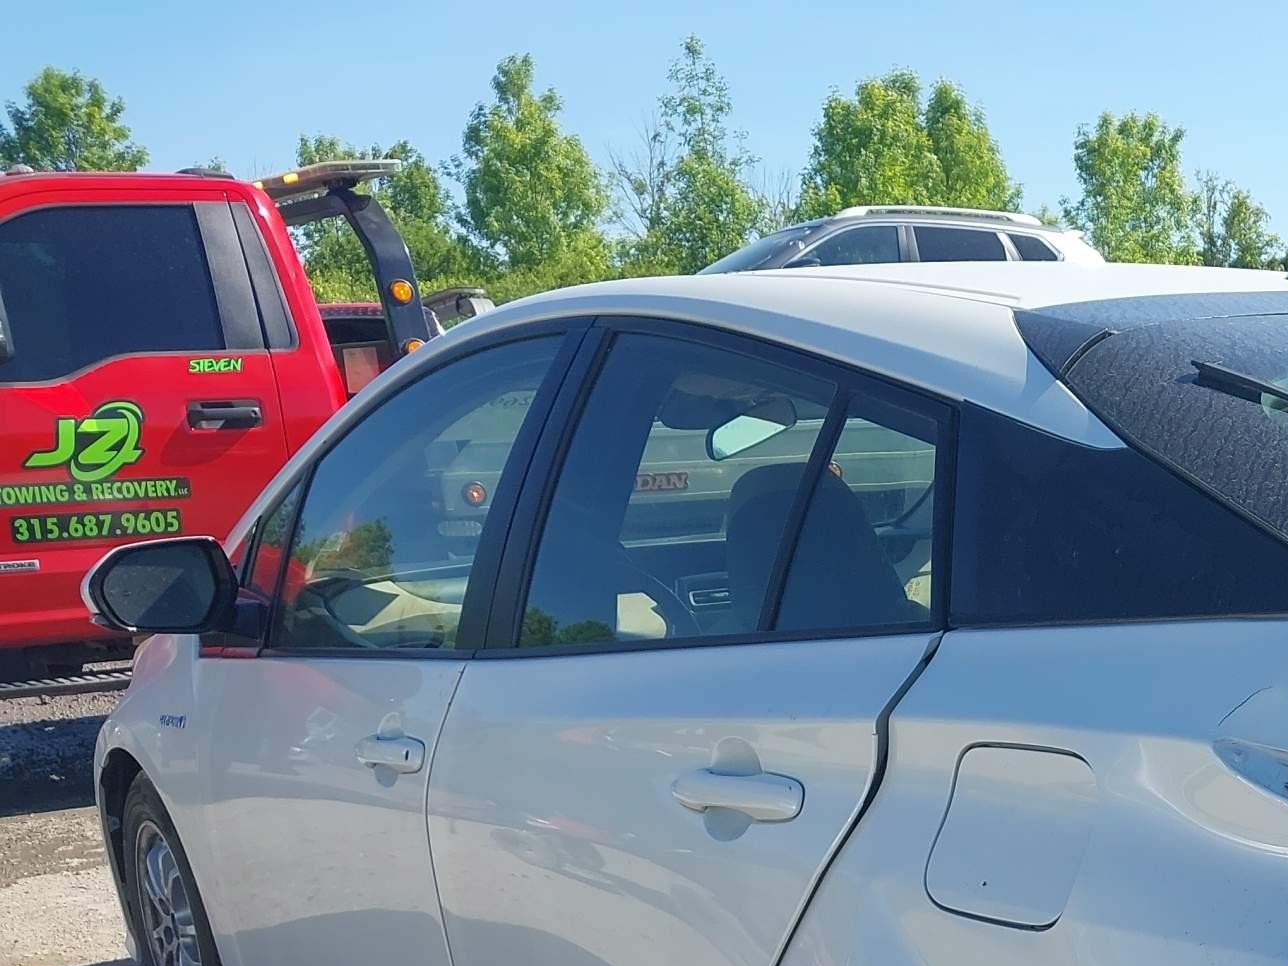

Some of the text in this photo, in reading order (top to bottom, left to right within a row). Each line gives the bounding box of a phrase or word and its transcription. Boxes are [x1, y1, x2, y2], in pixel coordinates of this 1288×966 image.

[188, 357, 242, 373] STEVEN
[0, 484, 69, 505] OWING
[74, 484, 88, 500] &
[14, 511, 179, 541] 315.687.9605
